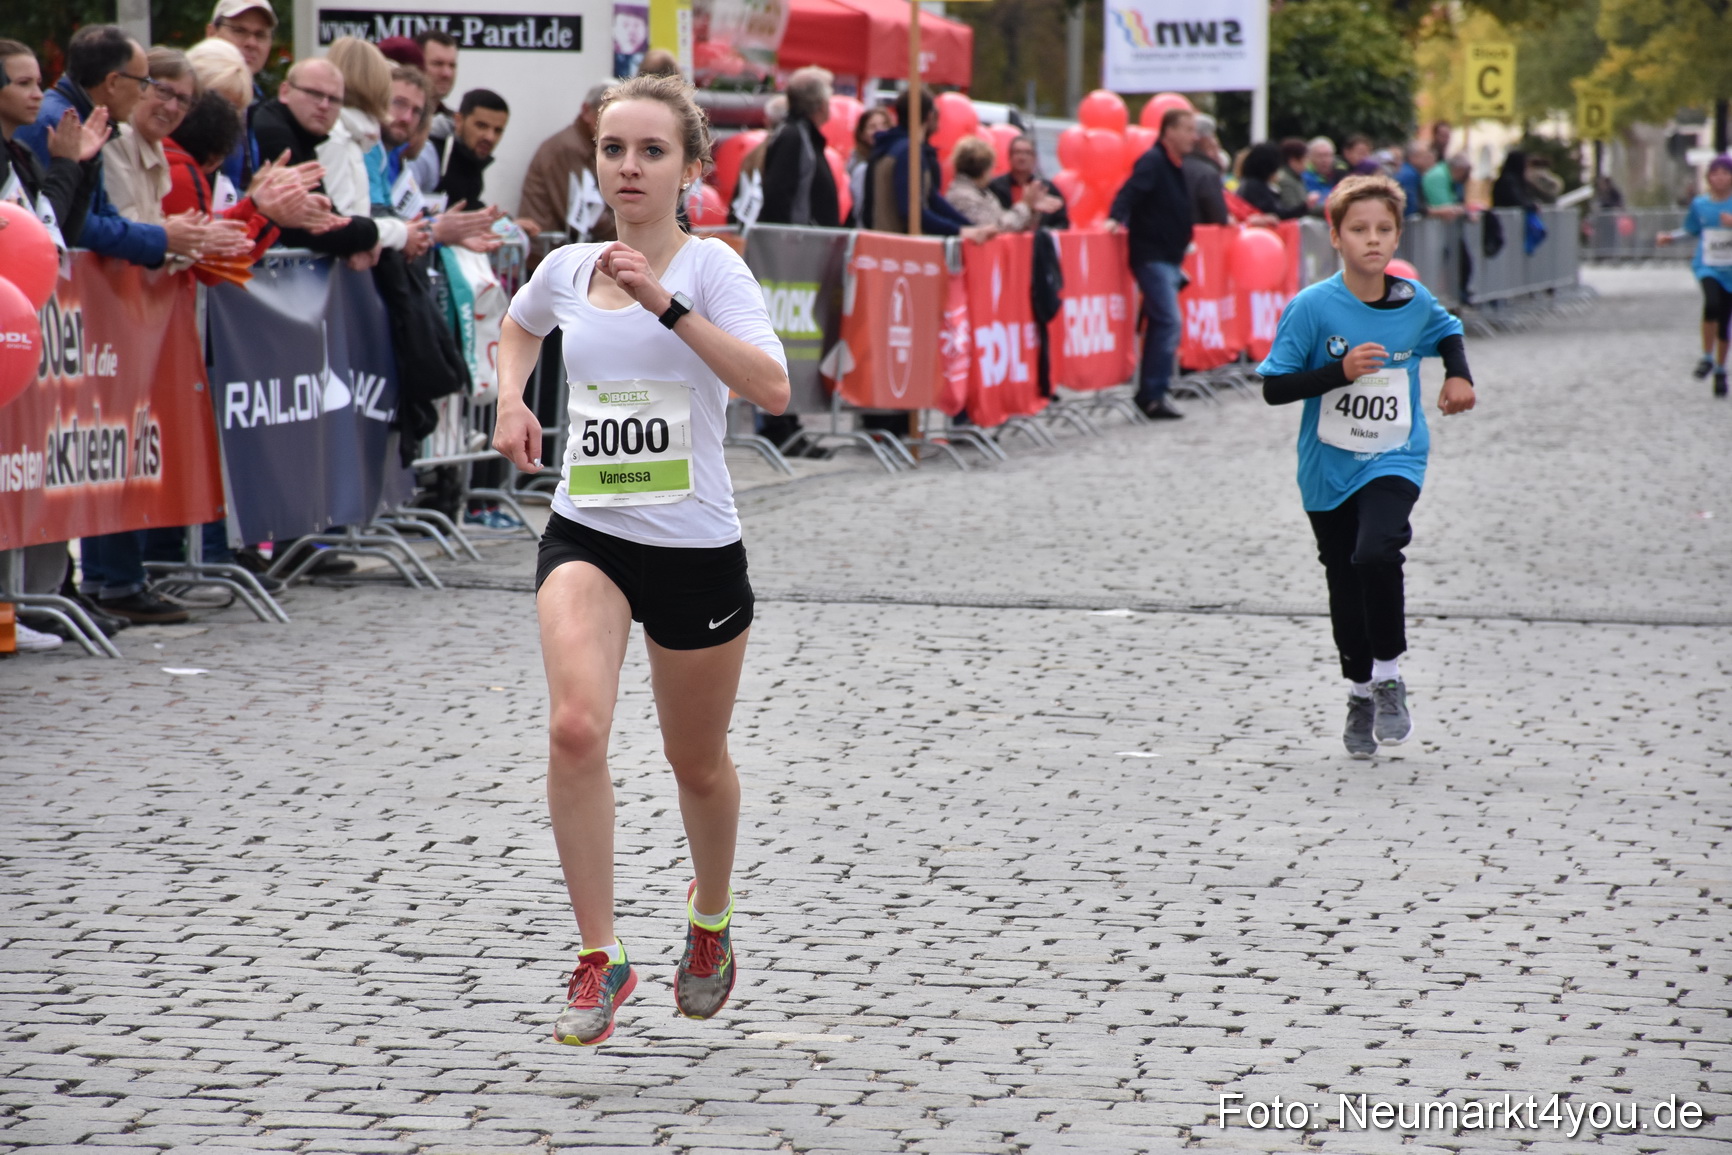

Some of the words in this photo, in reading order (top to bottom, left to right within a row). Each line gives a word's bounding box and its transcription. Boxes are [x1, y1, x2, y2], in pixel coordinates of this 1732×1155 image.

[1477, 65, 1501, 98] C
[1584, 103, 1605, 128] D
[610, 391, 650, 403] BOCK
[1335, 393, 1398, 421] 4003
[582, 417, 670, 457] 5000
[1350, 427, 1379, 438] Niklas
[599, 470, 652, 485] Vanessa
